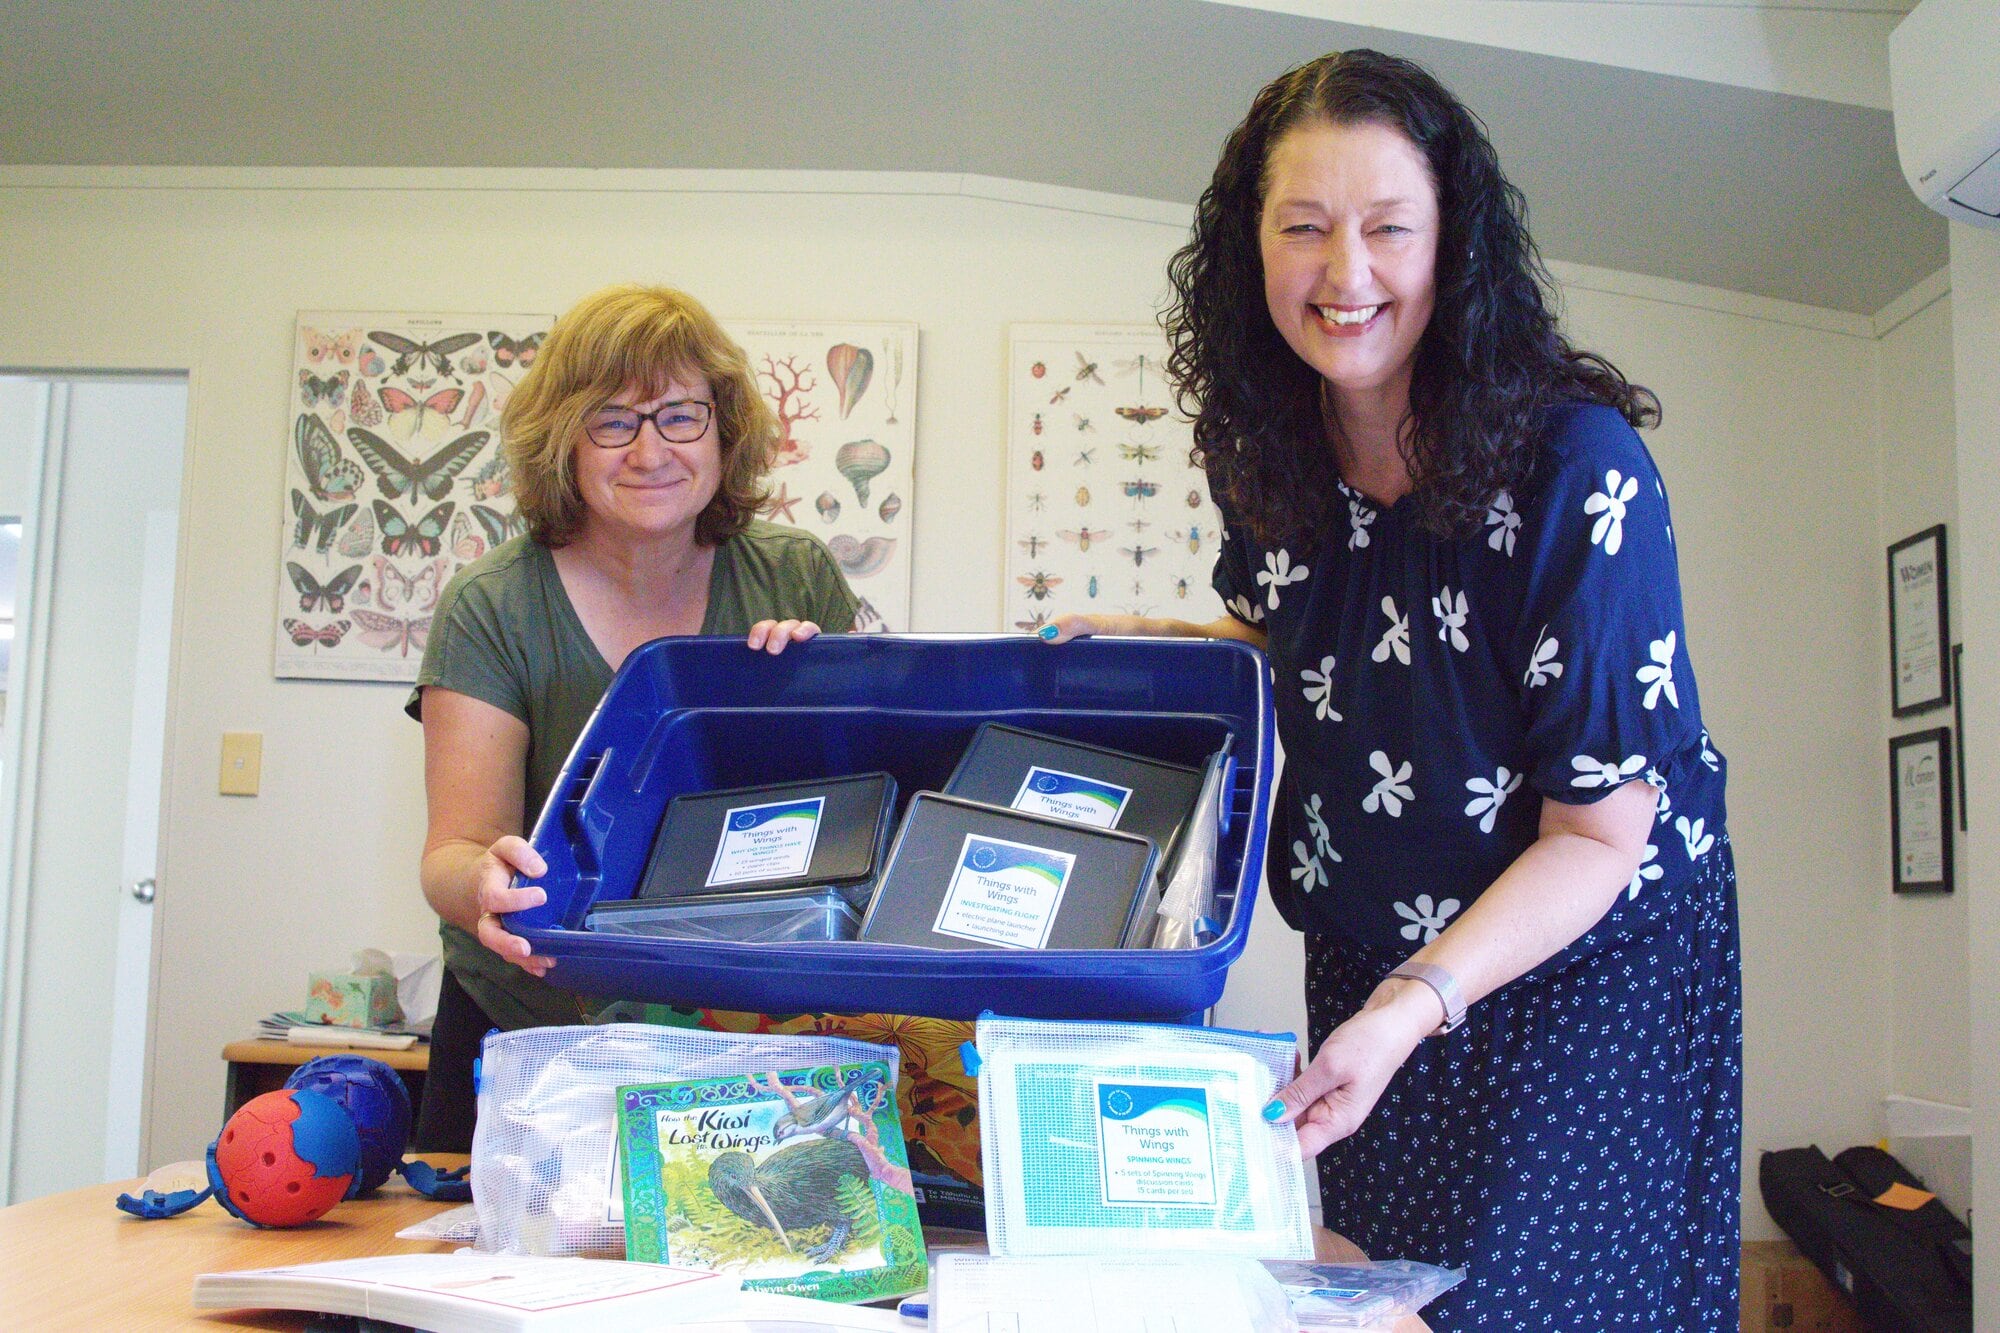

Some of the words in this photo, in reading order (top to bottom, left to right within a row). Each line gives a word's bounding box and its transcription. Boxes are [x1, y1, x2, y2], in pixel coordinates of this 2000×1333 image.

[1040, 795, 1073, 808] Things
[1075, 804, 1097, 815] with
[1050, 805, 1079, 818] Wings
[742, 829, 774, 838] Things
[777, 826, 798, 834] with
[753, 835, 783, 844] Wings
[759, 843, 784, 851] THINGS
[977, 875, 1011, 891] Things
[1014, 885, 1038, 897] with
[987, 889, 1019, 905] Wings
[960, 899, 1013, 916] INVESTIGATING
[1014, 910, 1040, 921] FLIGHT
[962, 911, 986, 922] electric
[987, 915, 1006, 926] plane
[1006, 918, 1036, 932] launcher
[971, 922, 1004, 936] launching
[1005, 929, 1019, 938] pad
[684, 1113, 697, 1121] the
[698, 1109, 752, 1131] Kiwi
[1122, 1124, 1161, 1138] Things
[1164, 1126, 1189, 1137] with
[668, 1128, 710, 1145] Lost
[711, 1132, 771, 1153] Wings
[1139, 1138, 1175, 1152] Wings
[1126, 1155, 1164, 1164] SPINNING
[1166, 1156, 1192, 1165] WINGS
[1136, 1178, 1174, 1187] discussion
[1175, 1179, 1194, 1187] cards
[1152, 1170, 1184, 1180] Spinning
[1185, 1171, 1207, 1181] Wings
[1167, 1188, 1180, 1196] per
[787, 1283, 820, 1292] Owen
